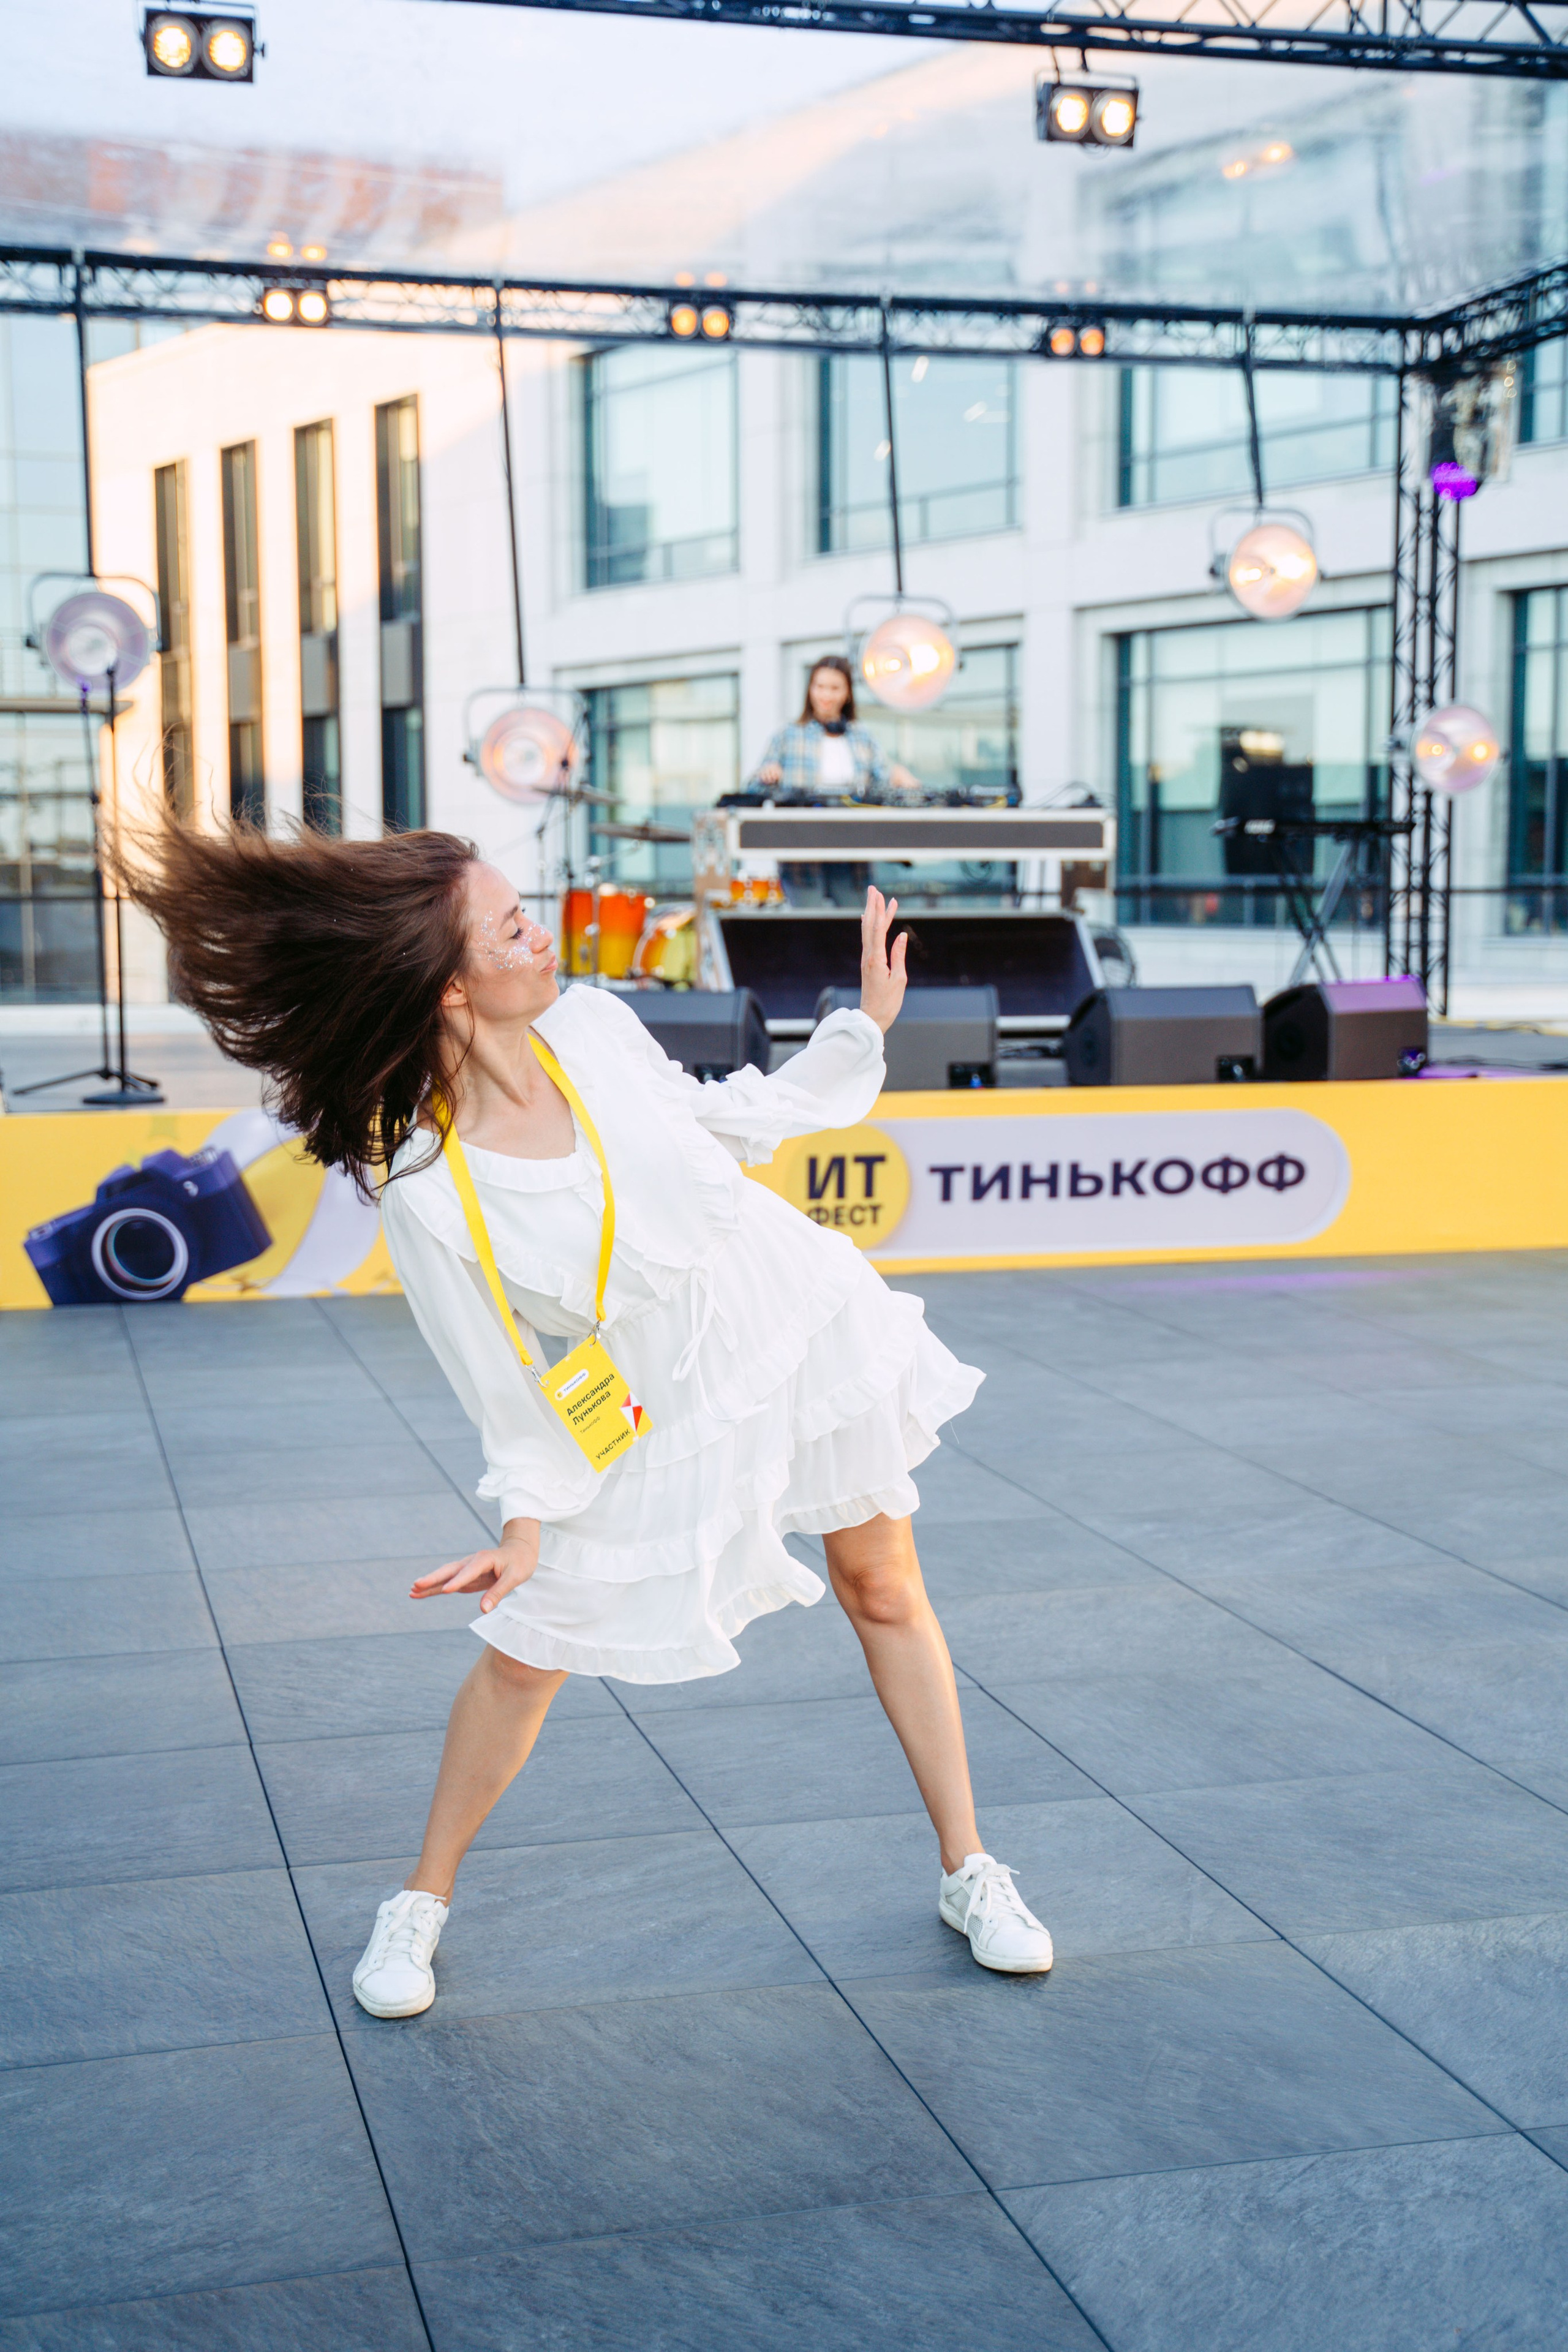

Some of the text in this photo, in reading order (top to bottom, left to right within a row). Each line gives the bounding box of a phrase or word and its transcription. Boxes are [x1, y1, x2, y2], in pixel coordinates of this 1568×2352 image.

[807, 1155, 886, 1199] ИТ
[929, 1153, 1307, 1202] ТИНЬКОФФ
[807, 1204, 882, 1226] ФЕСТ
[567, 1373, 615, 1416] Александра
[572, 1391, 611, 1425] Лунькова
[595, 1429, 630, 1460] УЧАСТНИК
